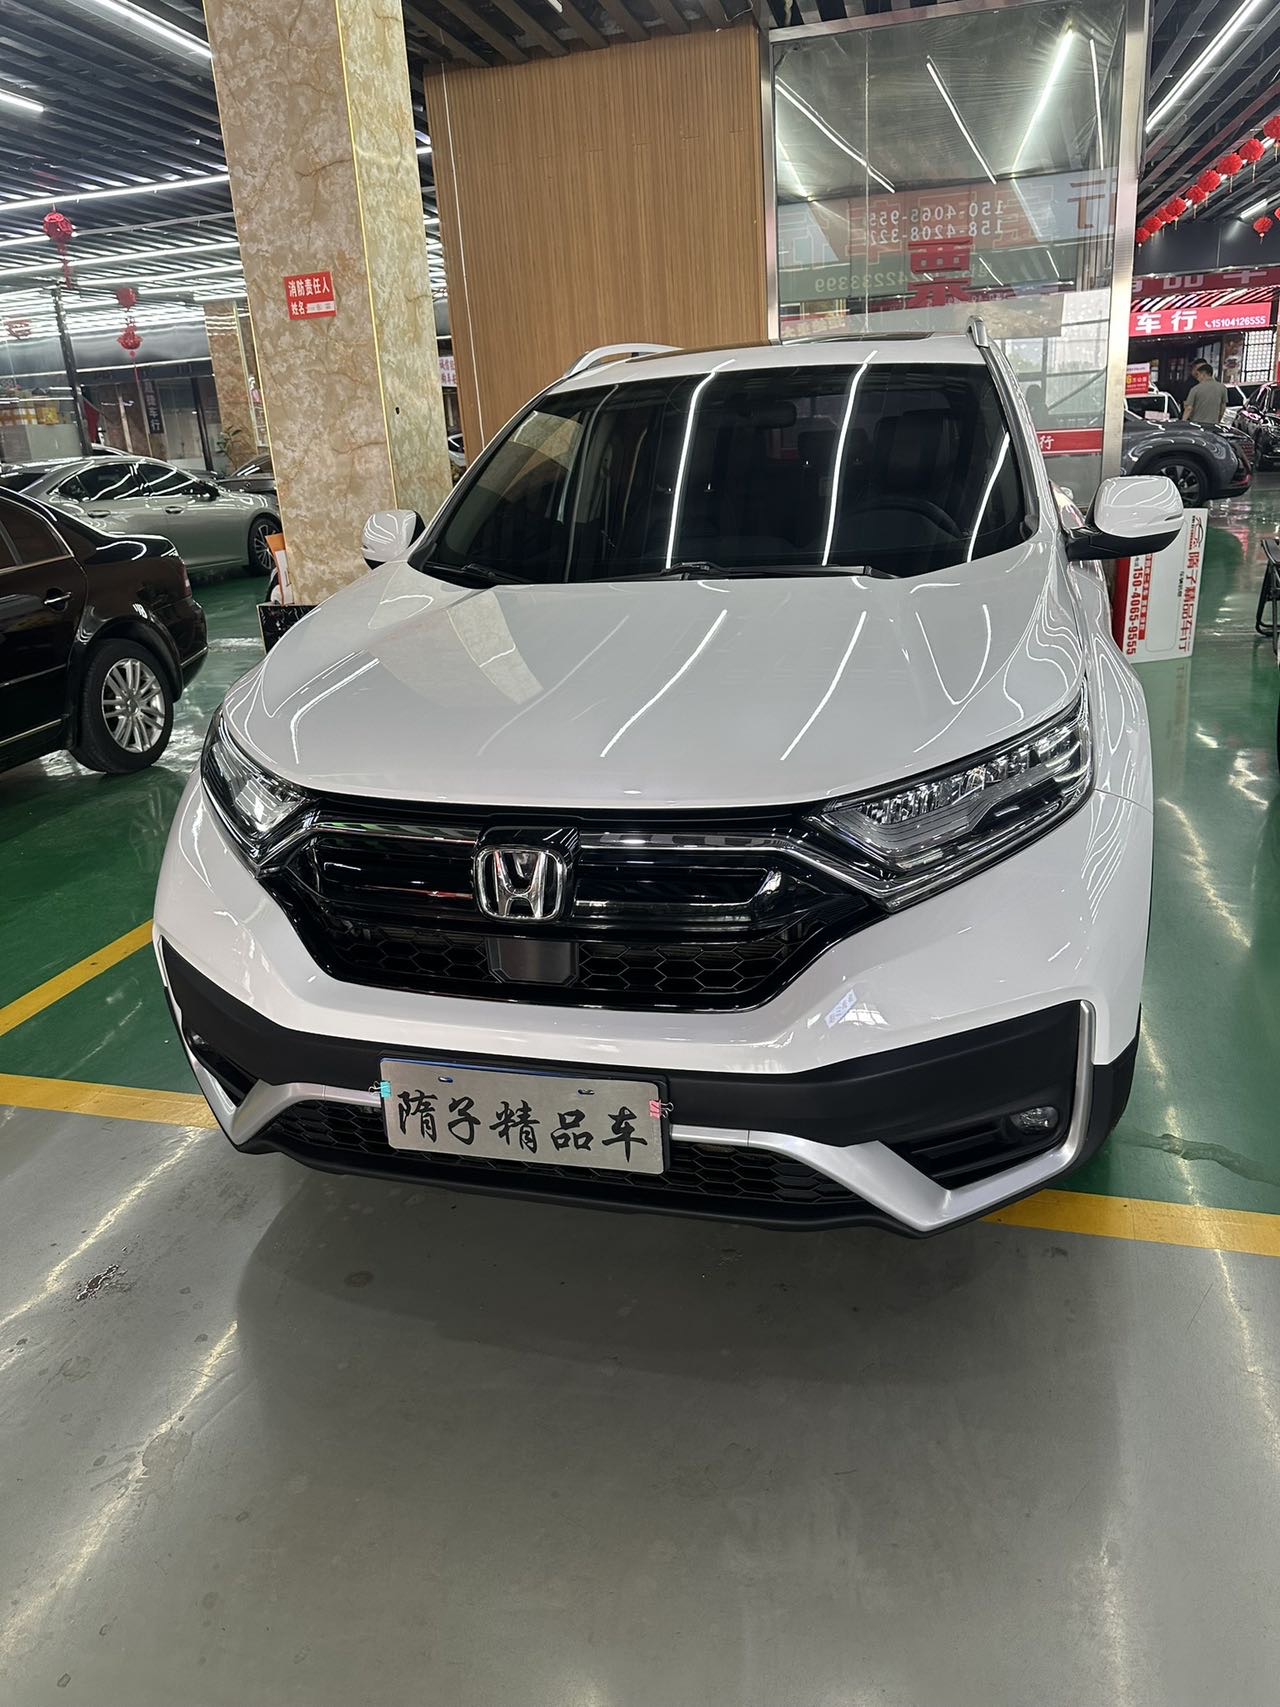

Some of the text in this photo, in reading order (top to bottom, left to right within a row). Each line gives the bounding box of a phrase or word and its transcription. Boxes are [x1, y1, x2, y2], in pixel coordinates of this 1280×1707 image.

[288, 276, 330, 298] 消防责任人
[1135, 310, 1266, 334] 车行 15104126555
[1126, 566, 1144, 655] 150-4065-9555
[397, 1089, 648, 1163] 隋子精品车
